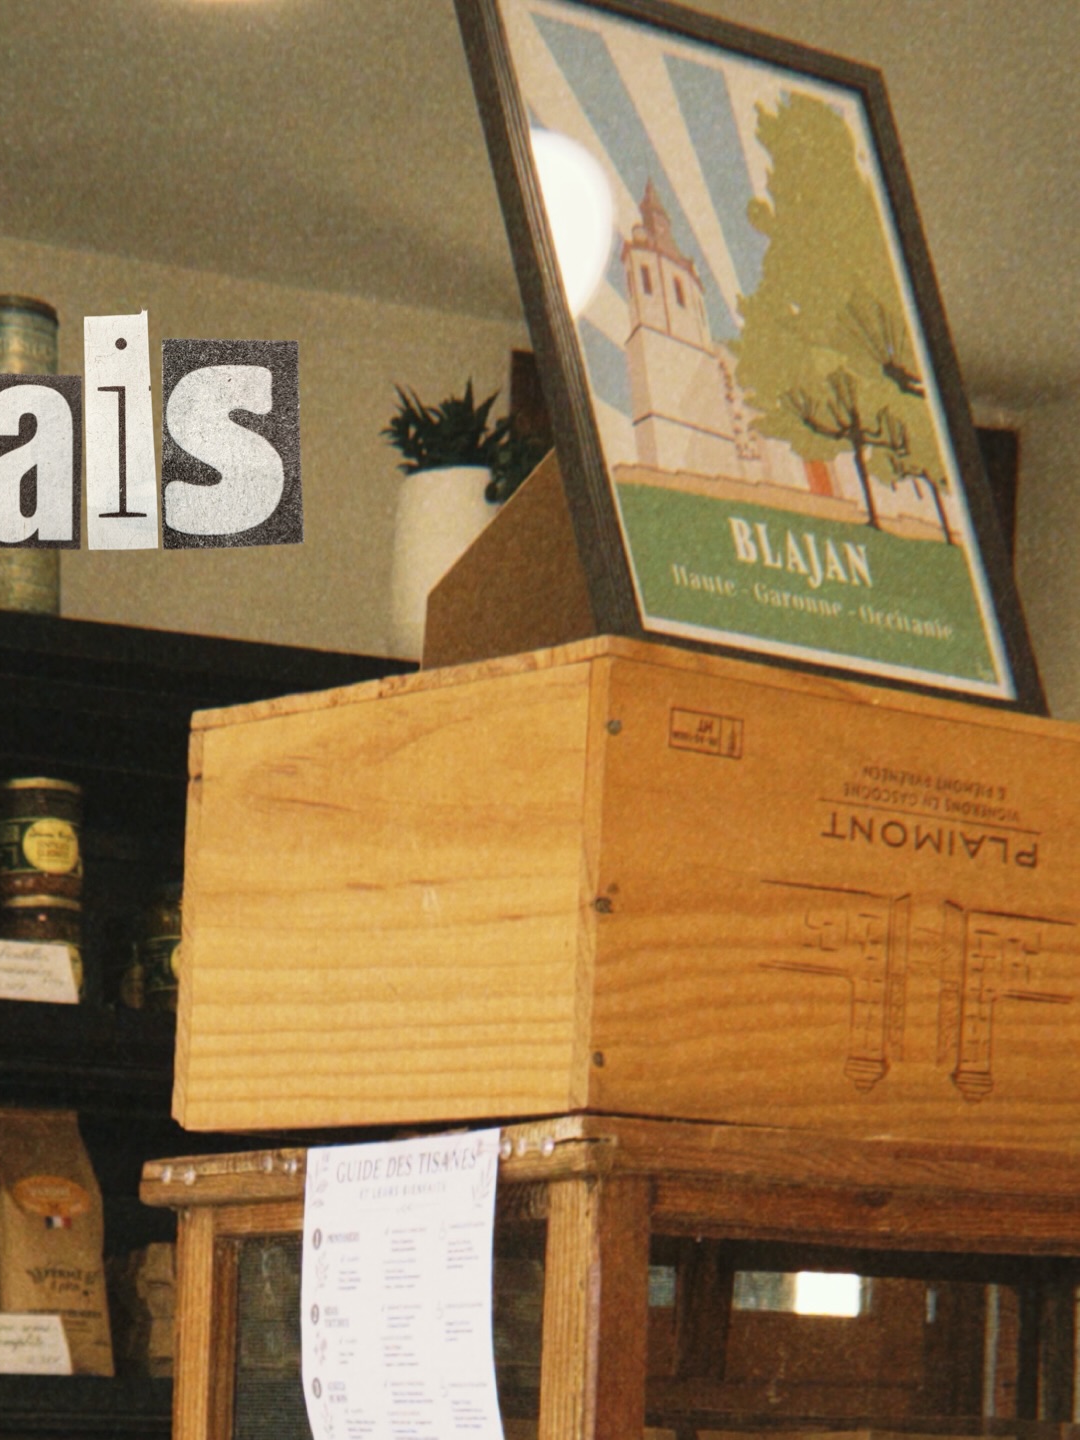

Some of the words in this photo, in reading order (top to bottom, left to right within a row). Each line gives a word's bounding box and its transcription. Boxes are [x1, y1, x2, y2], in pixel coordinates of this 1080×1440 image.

[728, 517, 873, 588] BLAJAN
[672, 563, 735, 597] Haute
[754, 583, 843, 617] Garonne
[858, 604, 954, 640] Occitanie
[843, 781, 917, 807] GASCOGNE
[945, 801, 1020, 822] VIGNERONS
[821, 811, 1038, 869] PLAIMONT
[336, 1158, 382, 1184] GUIDE
[386, 1153, 412, 1179] DES
[418, 1147, 477, 1175] TISANES
